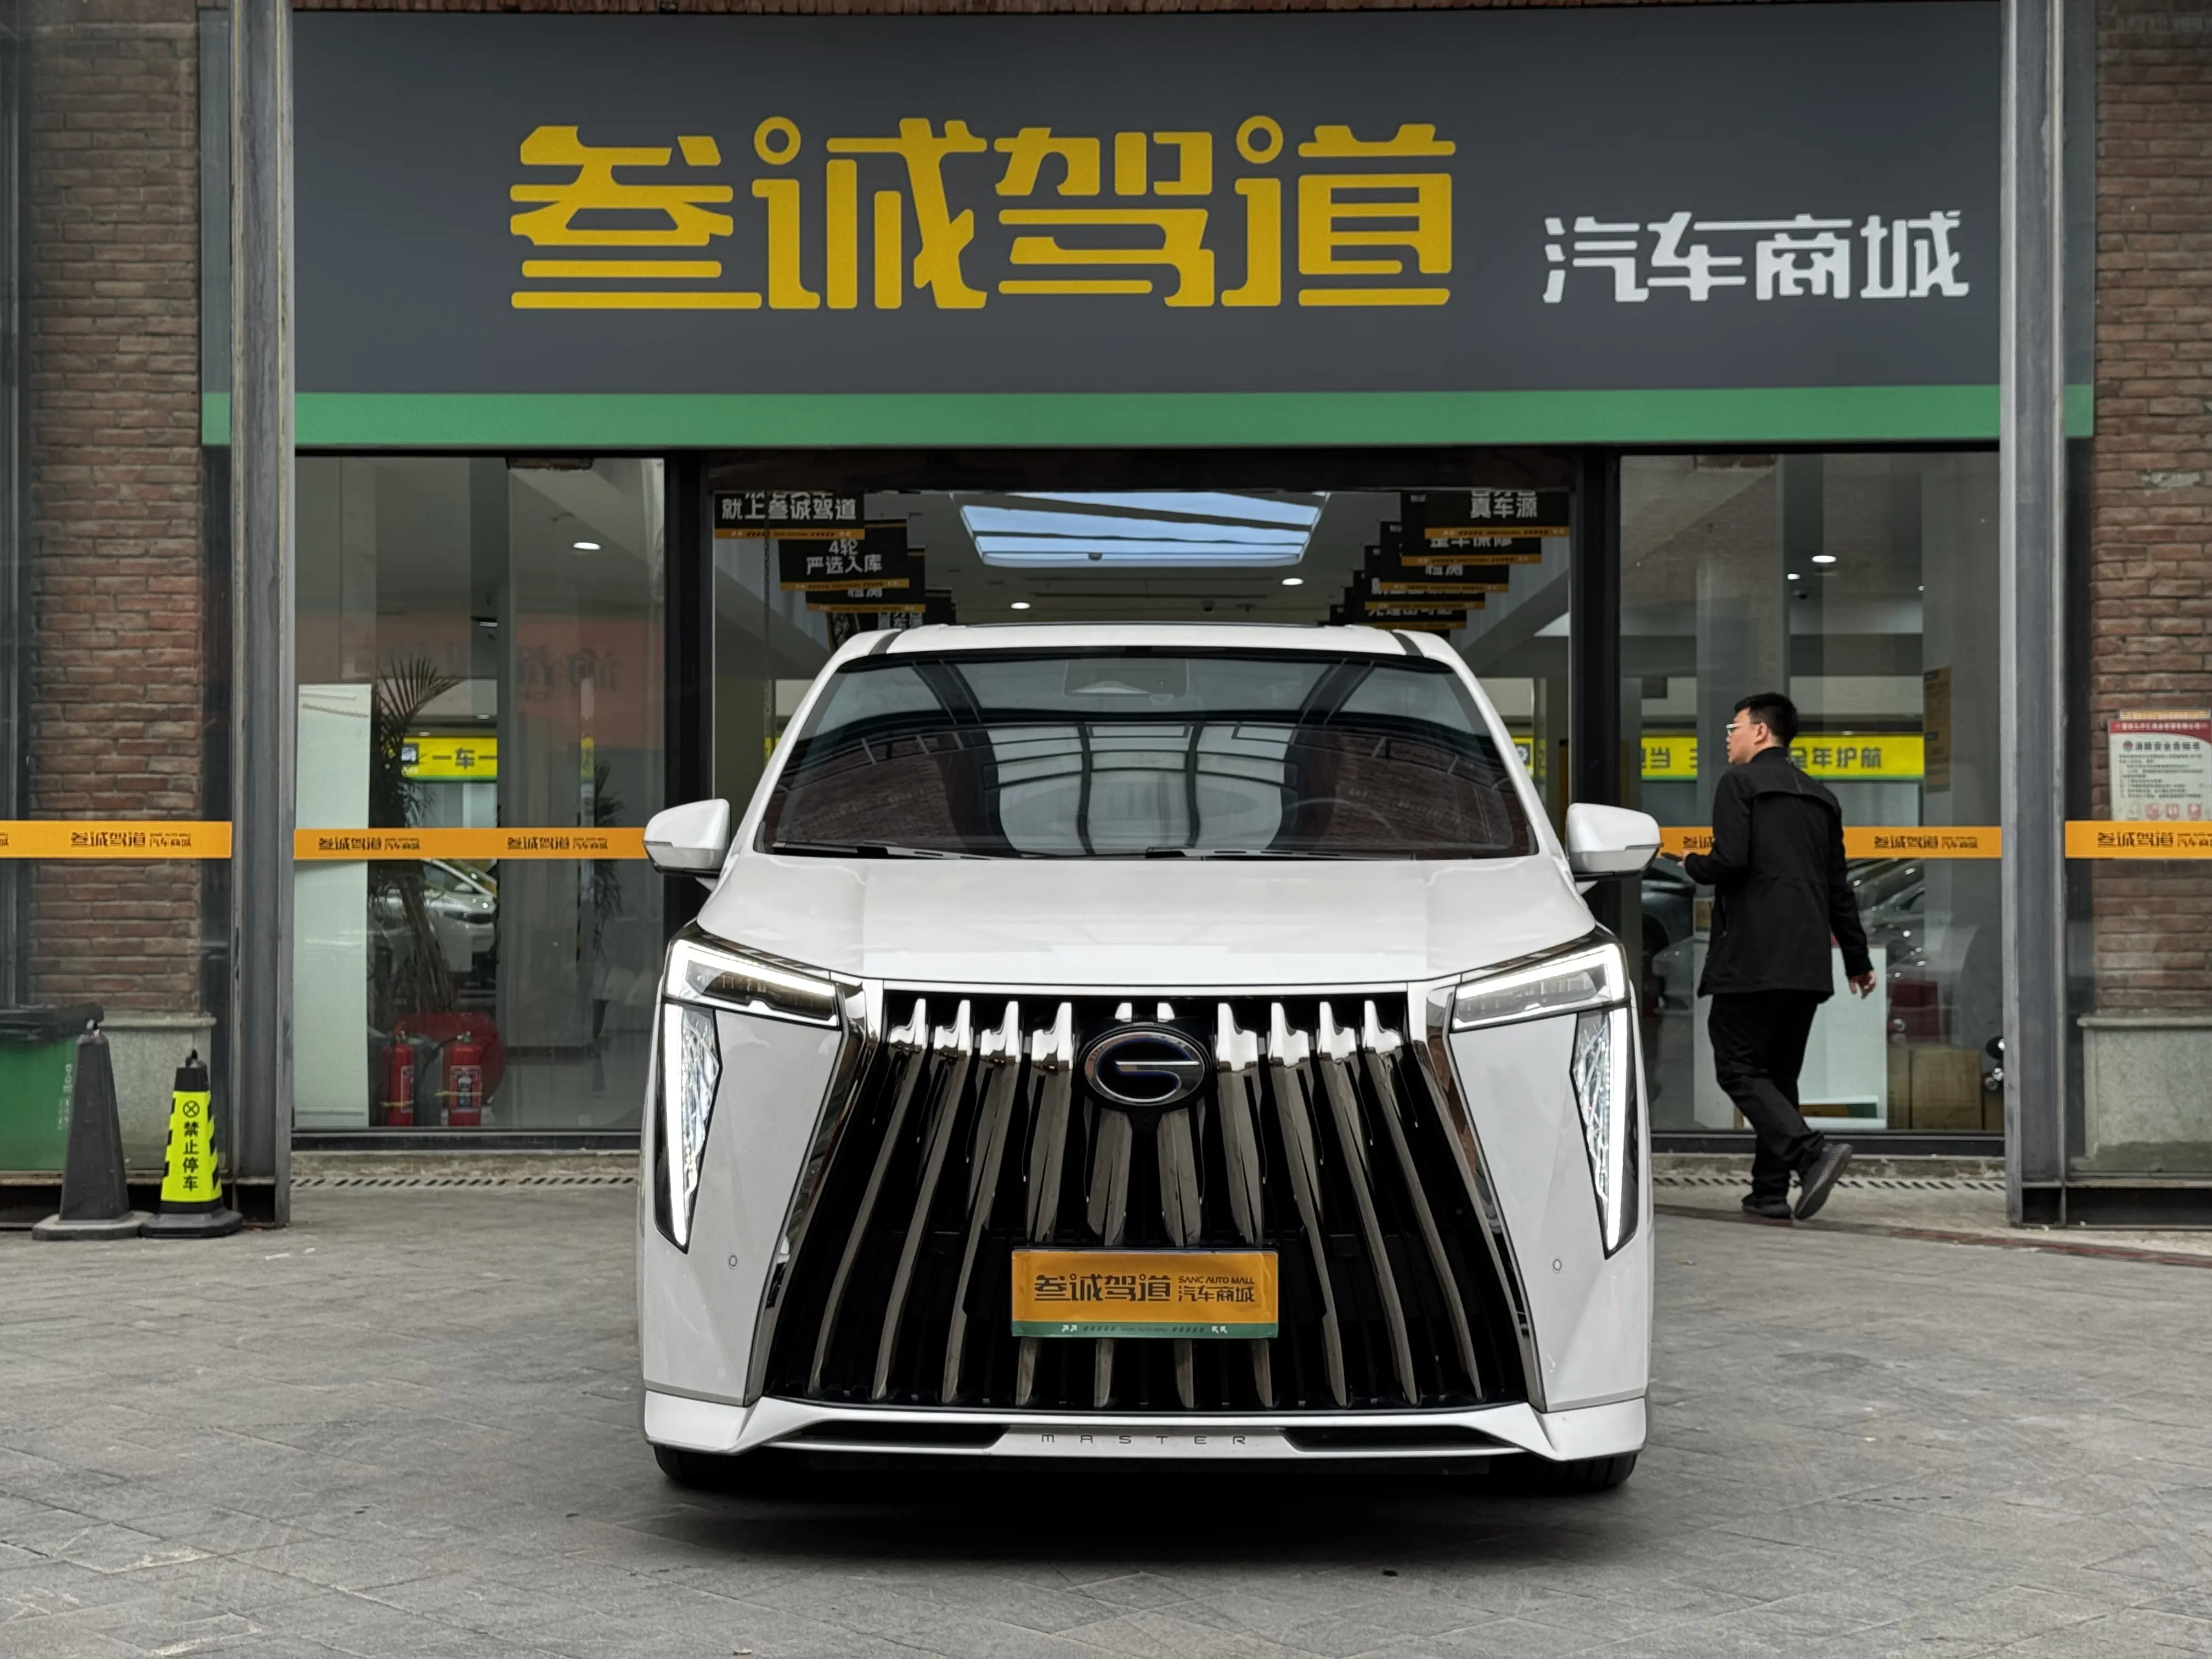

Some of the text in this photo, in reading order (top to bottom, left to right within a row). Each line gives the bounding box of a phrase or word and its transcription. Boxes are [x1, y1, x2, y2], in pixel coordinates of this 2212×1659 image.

[510, 116, 1455, 308] 叁诚驾道
[1543, 211, 1969, 303] 汽车商城
[806, 554, 882, 575] 严选入库
[182, 1121, 199, 1192] 禁止停车
[1034, 1273, 1171, 1302] 叁诚驾道
[1178, 1285, 1255, 1302] 汽车商城
[1042, 1434, 1246, 1445] MASTER
